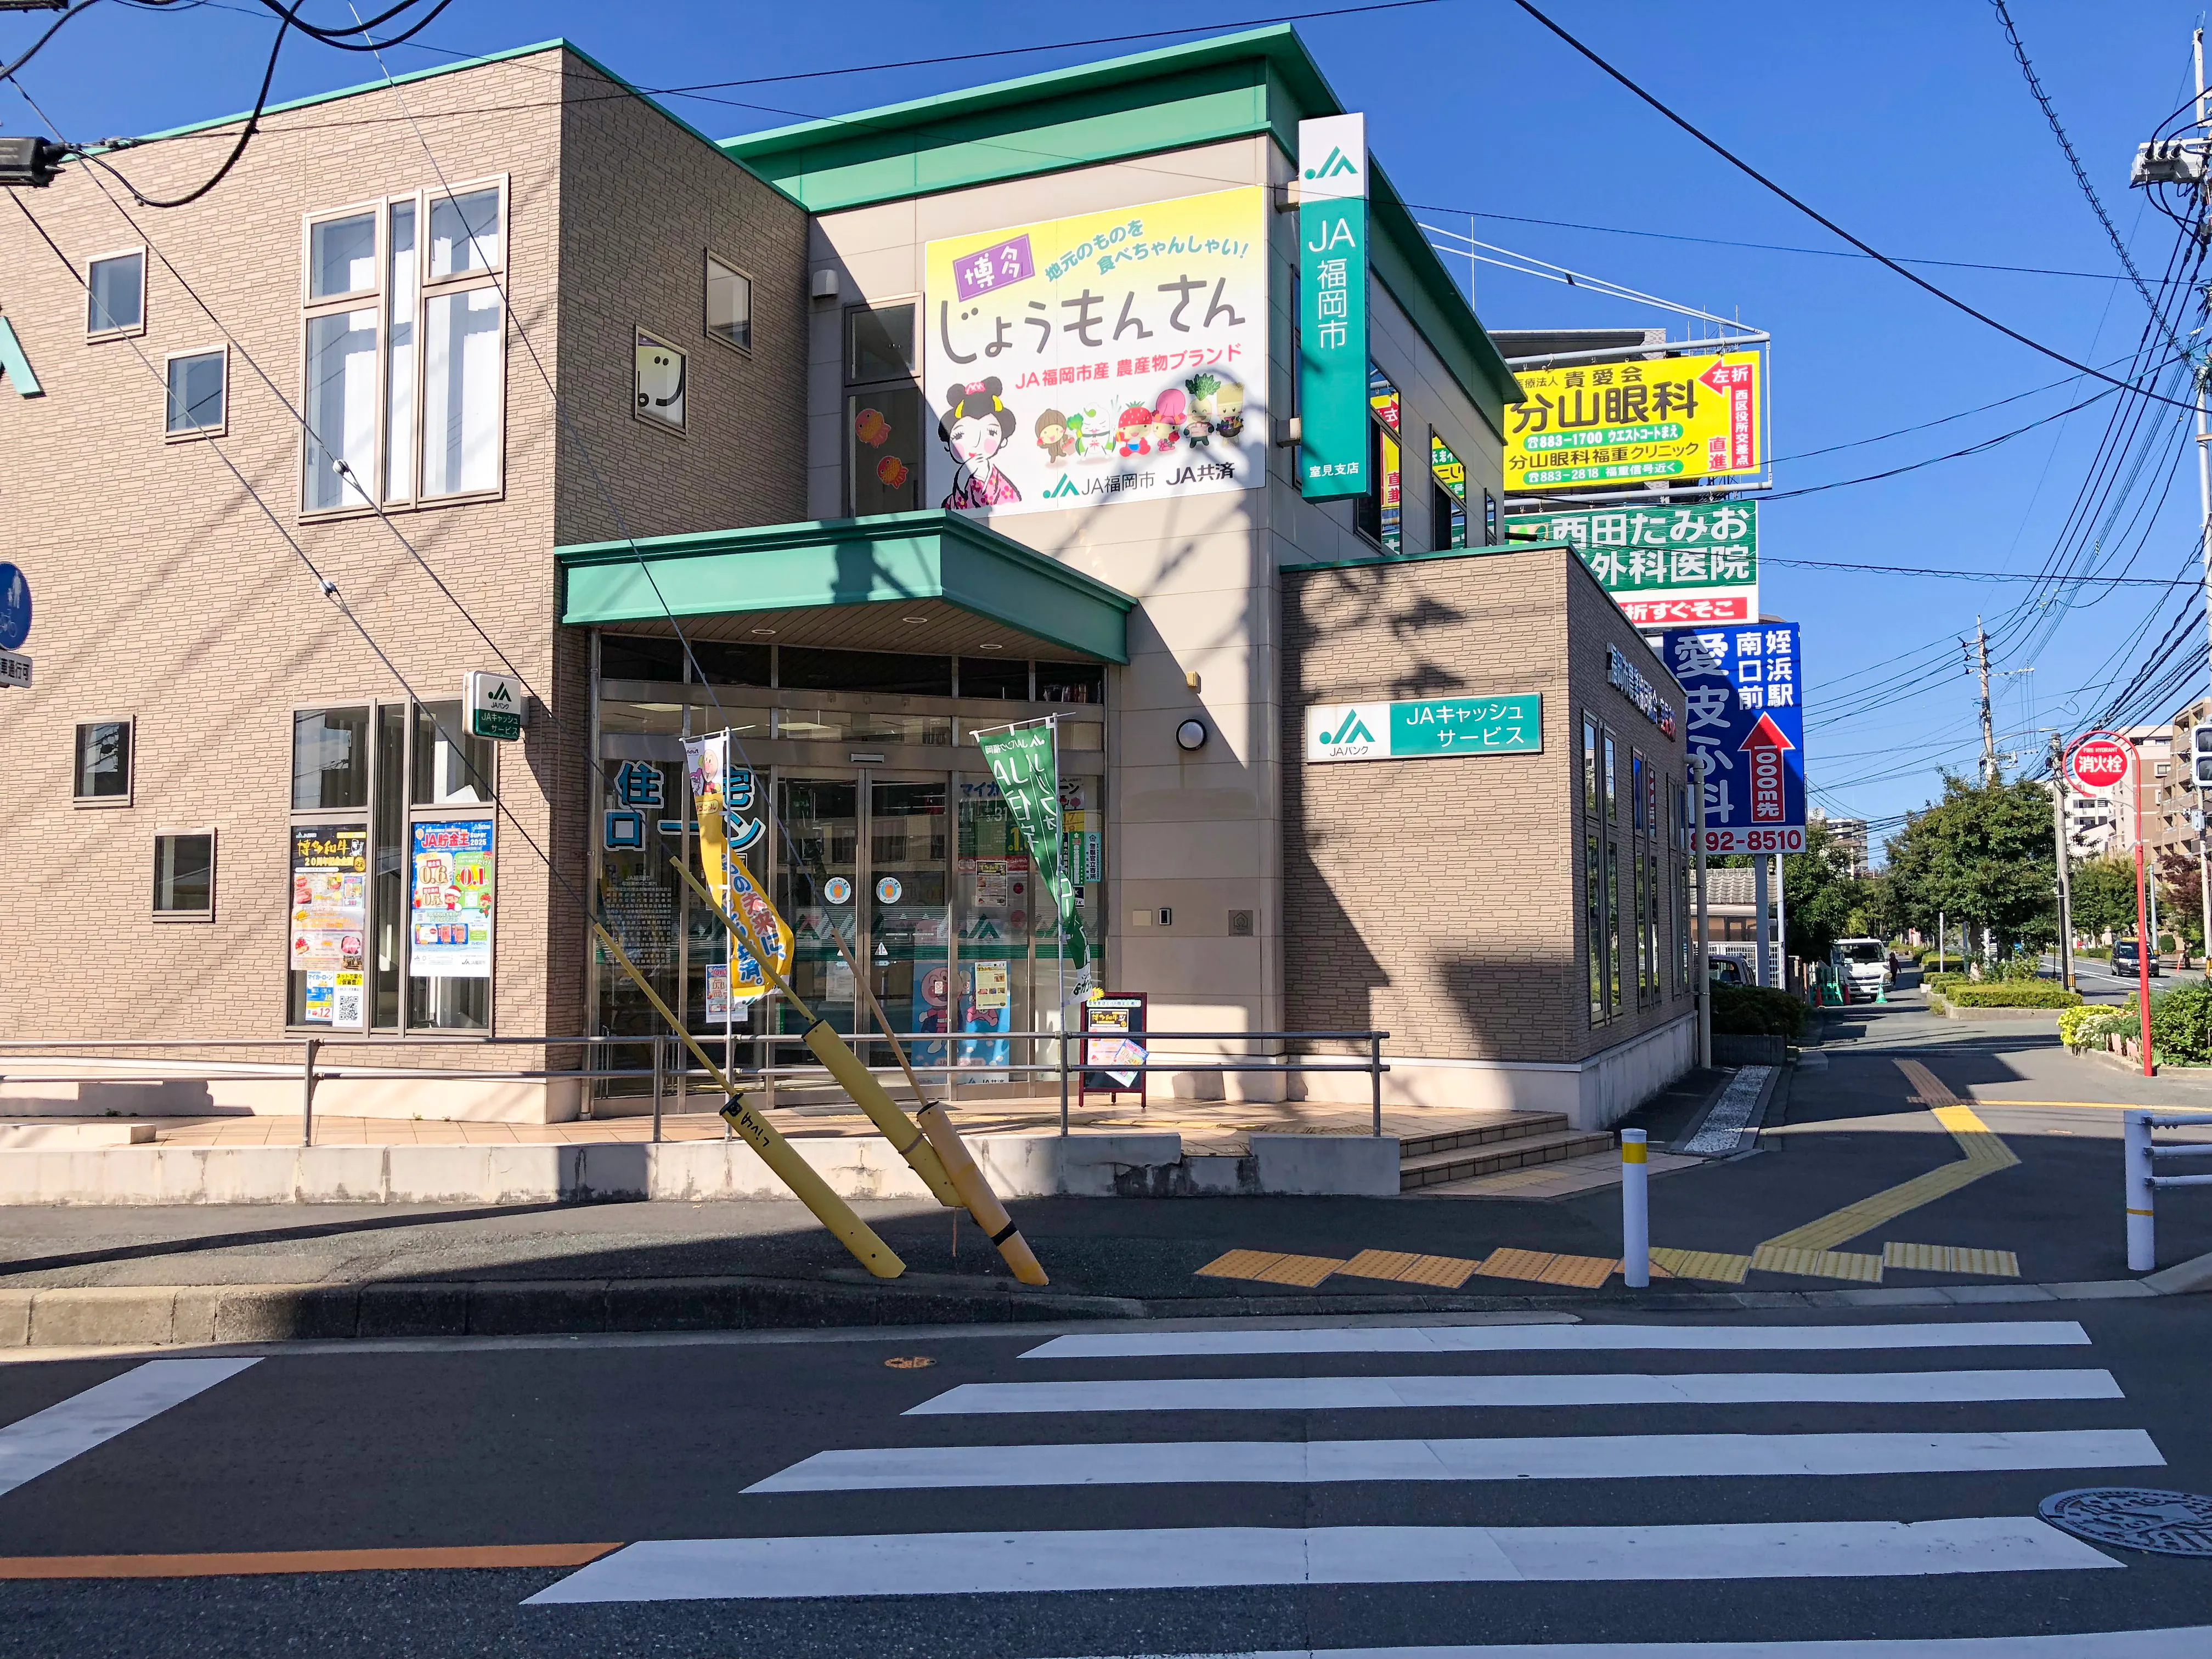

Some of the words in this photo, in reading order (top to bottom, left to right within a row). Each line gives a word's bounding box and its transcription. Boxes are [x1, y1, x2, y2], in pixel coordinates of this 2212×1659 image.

[1045, 220, 1144, 282] 地元のものを
[1098, 234, 1249, 275] 食べちゃんしゃい!
[964, 245, 1022, 289] 博多
[940, 274, 1246, 364] じょうもんさん
[1015, 362, 1110, 390] JA福岡市産
[1116, 343, 1242, 377] 農産物ブランド
[1564, 366, 1643, 388] 貴愛会
[1712, 366, 1748, 384] 左折
[1510, 378, 1699, 435] 分山眼科
[1539, 431, 1602, 447] 883-1700
[1608, 425, 1678, 442] ウエストコートまえ
[1734, 388, 1750, 466] 西区役所交差点
[1510, 441, 1699, 470] 分山眼科福重クリニック
[1708, 436, 1728, 470] 直進
[1081, 471, 1155, 495] JA福岡市
[1166, 462, 1236, 486] JA共済
[1309, 462, 1359, 479] 室見支店
[1539, 467, 1599, 482] 883-2818
[1606, 461, 1676, 478] 福重信号近く
[1551, 507, 1750, 549] 西田たみお
[1591, 546, 1750, 586] 外科医院
[1622, 601, 1734, 621] 折すぐそこ
[1736, 632, 1763, 710] 南口前
[1766, 630, 1794, 708] 姪浜駅
[482, 713, 518, 724] JAキャッシュ
[1406, 704, 1523, 725] JAキャッシュ
[492, 725, 517, 735] サービス
[1437, 727, 1524, 748] サービス
[1330, 746, 1368, 757] JAバンク
[2078, 755, 2123, 774] 消火栓
[422, 833, 470, 848] JA貯金王
[604, 809, 766, 852] ローン
[297, 839, 351, 857] 博多和牛
